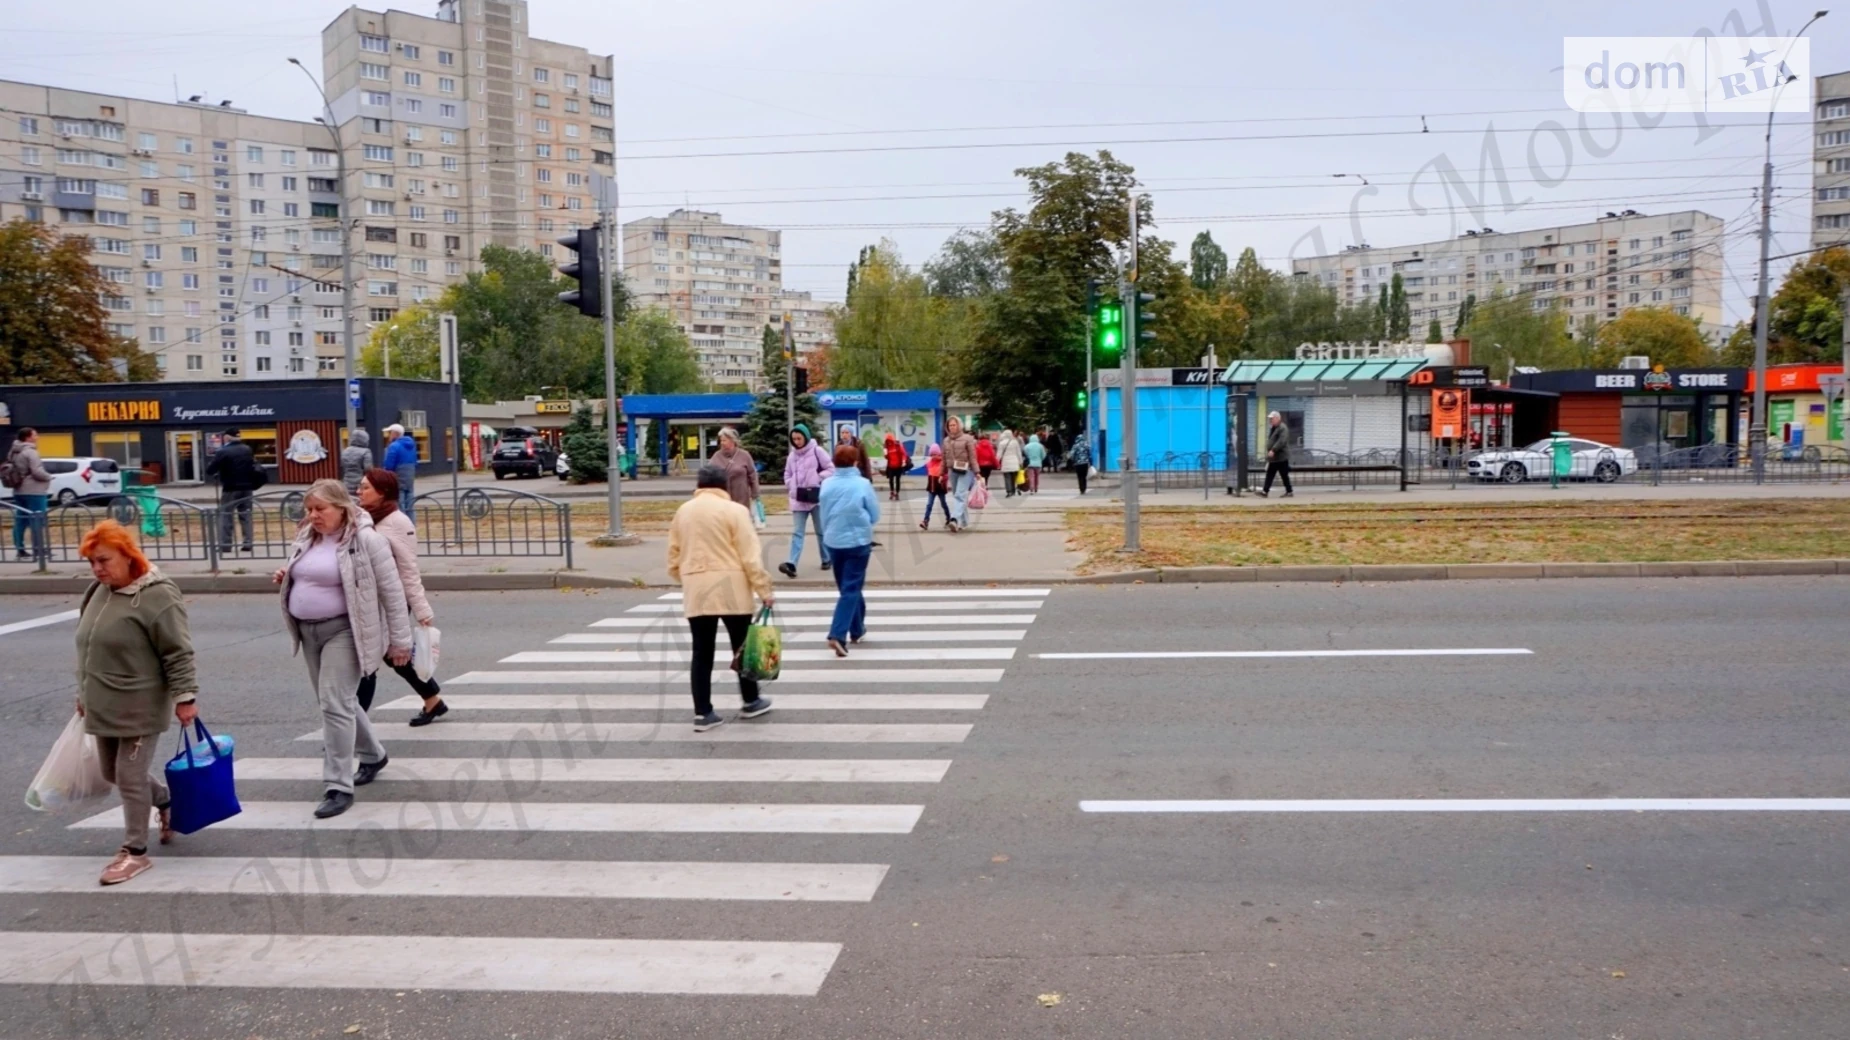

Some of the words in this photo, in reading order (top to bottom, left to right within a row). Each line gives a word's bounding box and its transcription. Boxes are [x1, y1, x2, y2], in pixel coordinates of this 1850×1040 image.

[1595, 374, 1636, 388] BEER
[1678, 373, 1727, 387] STORE
[87, 400, 161, 421] ПЕКАРНЯ
[173, 406, 229, 420] Хрусткий
[230, 404, 275, 416] Хлібчик
